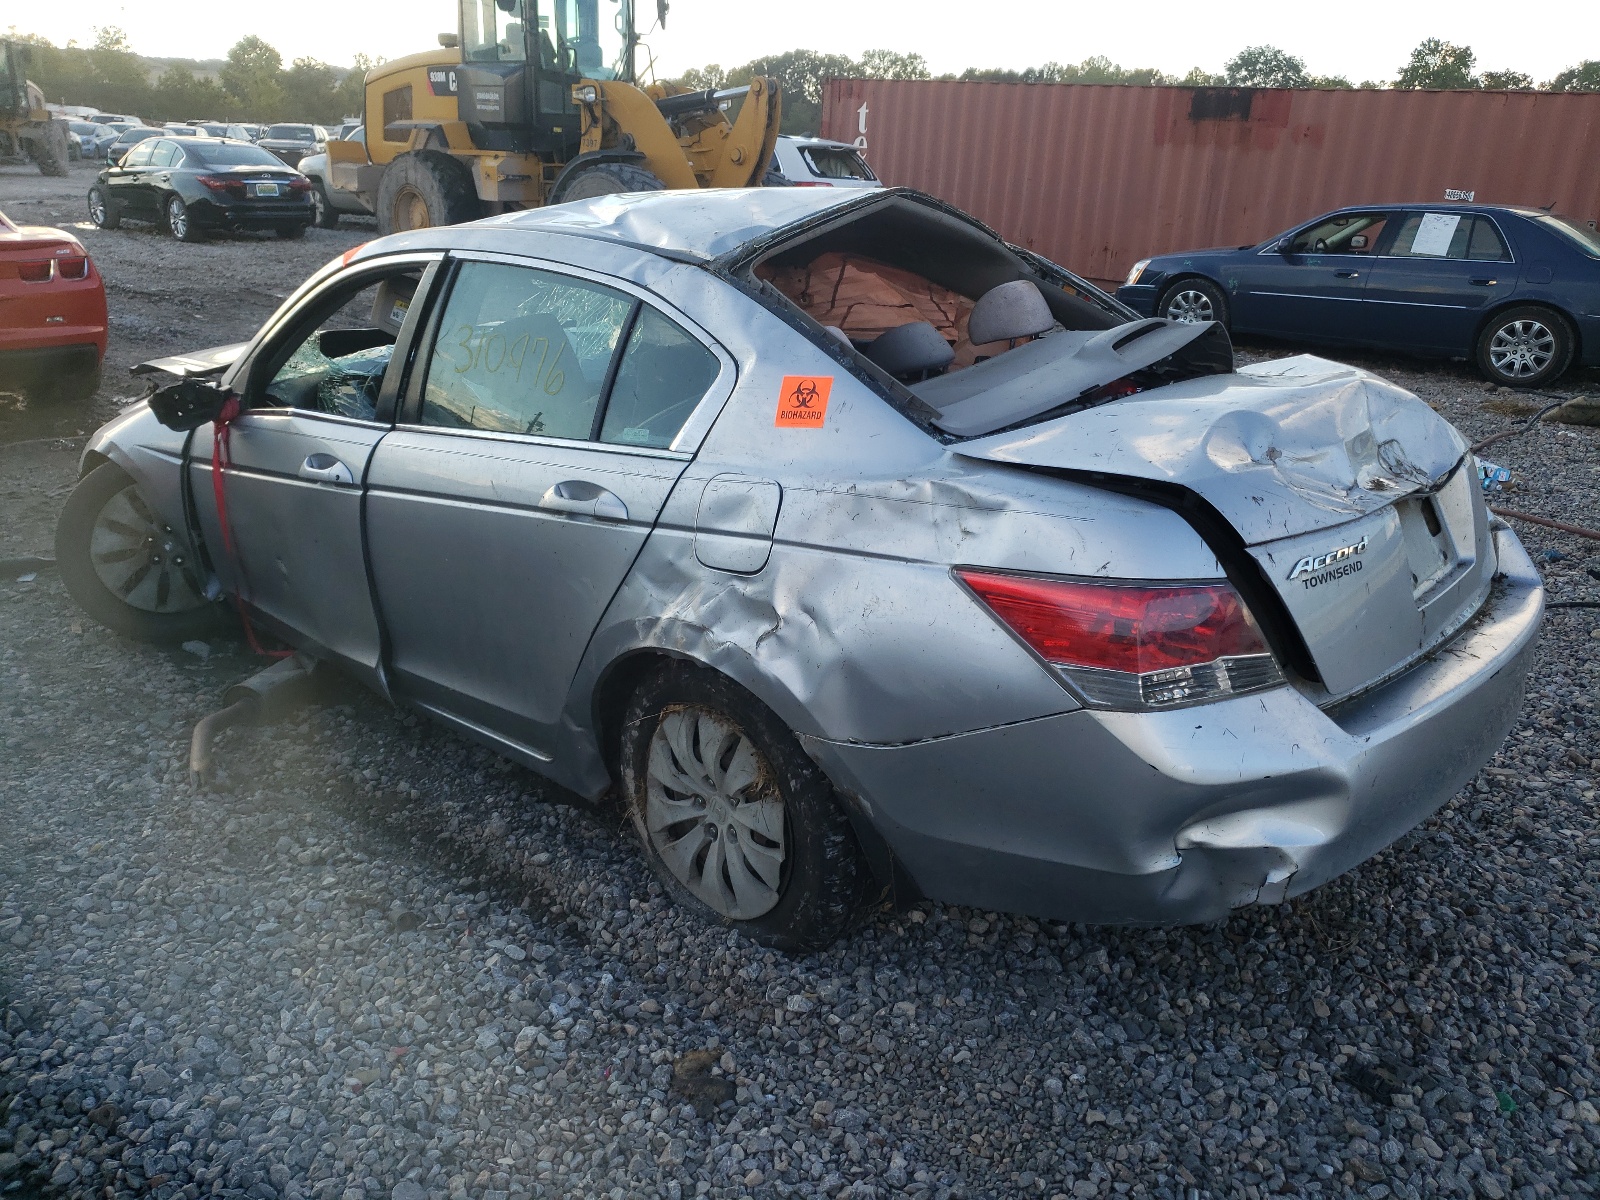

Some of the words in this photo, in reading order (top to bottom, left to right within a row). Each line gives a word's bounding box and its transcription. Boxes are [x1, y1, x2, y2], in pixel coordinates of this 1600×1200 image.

[780, 410, 823, 420] BIOHAZARD
[1287, 535, 1369, 580] Accord
[1302, 560, 1364, 590] TOWNSEND
